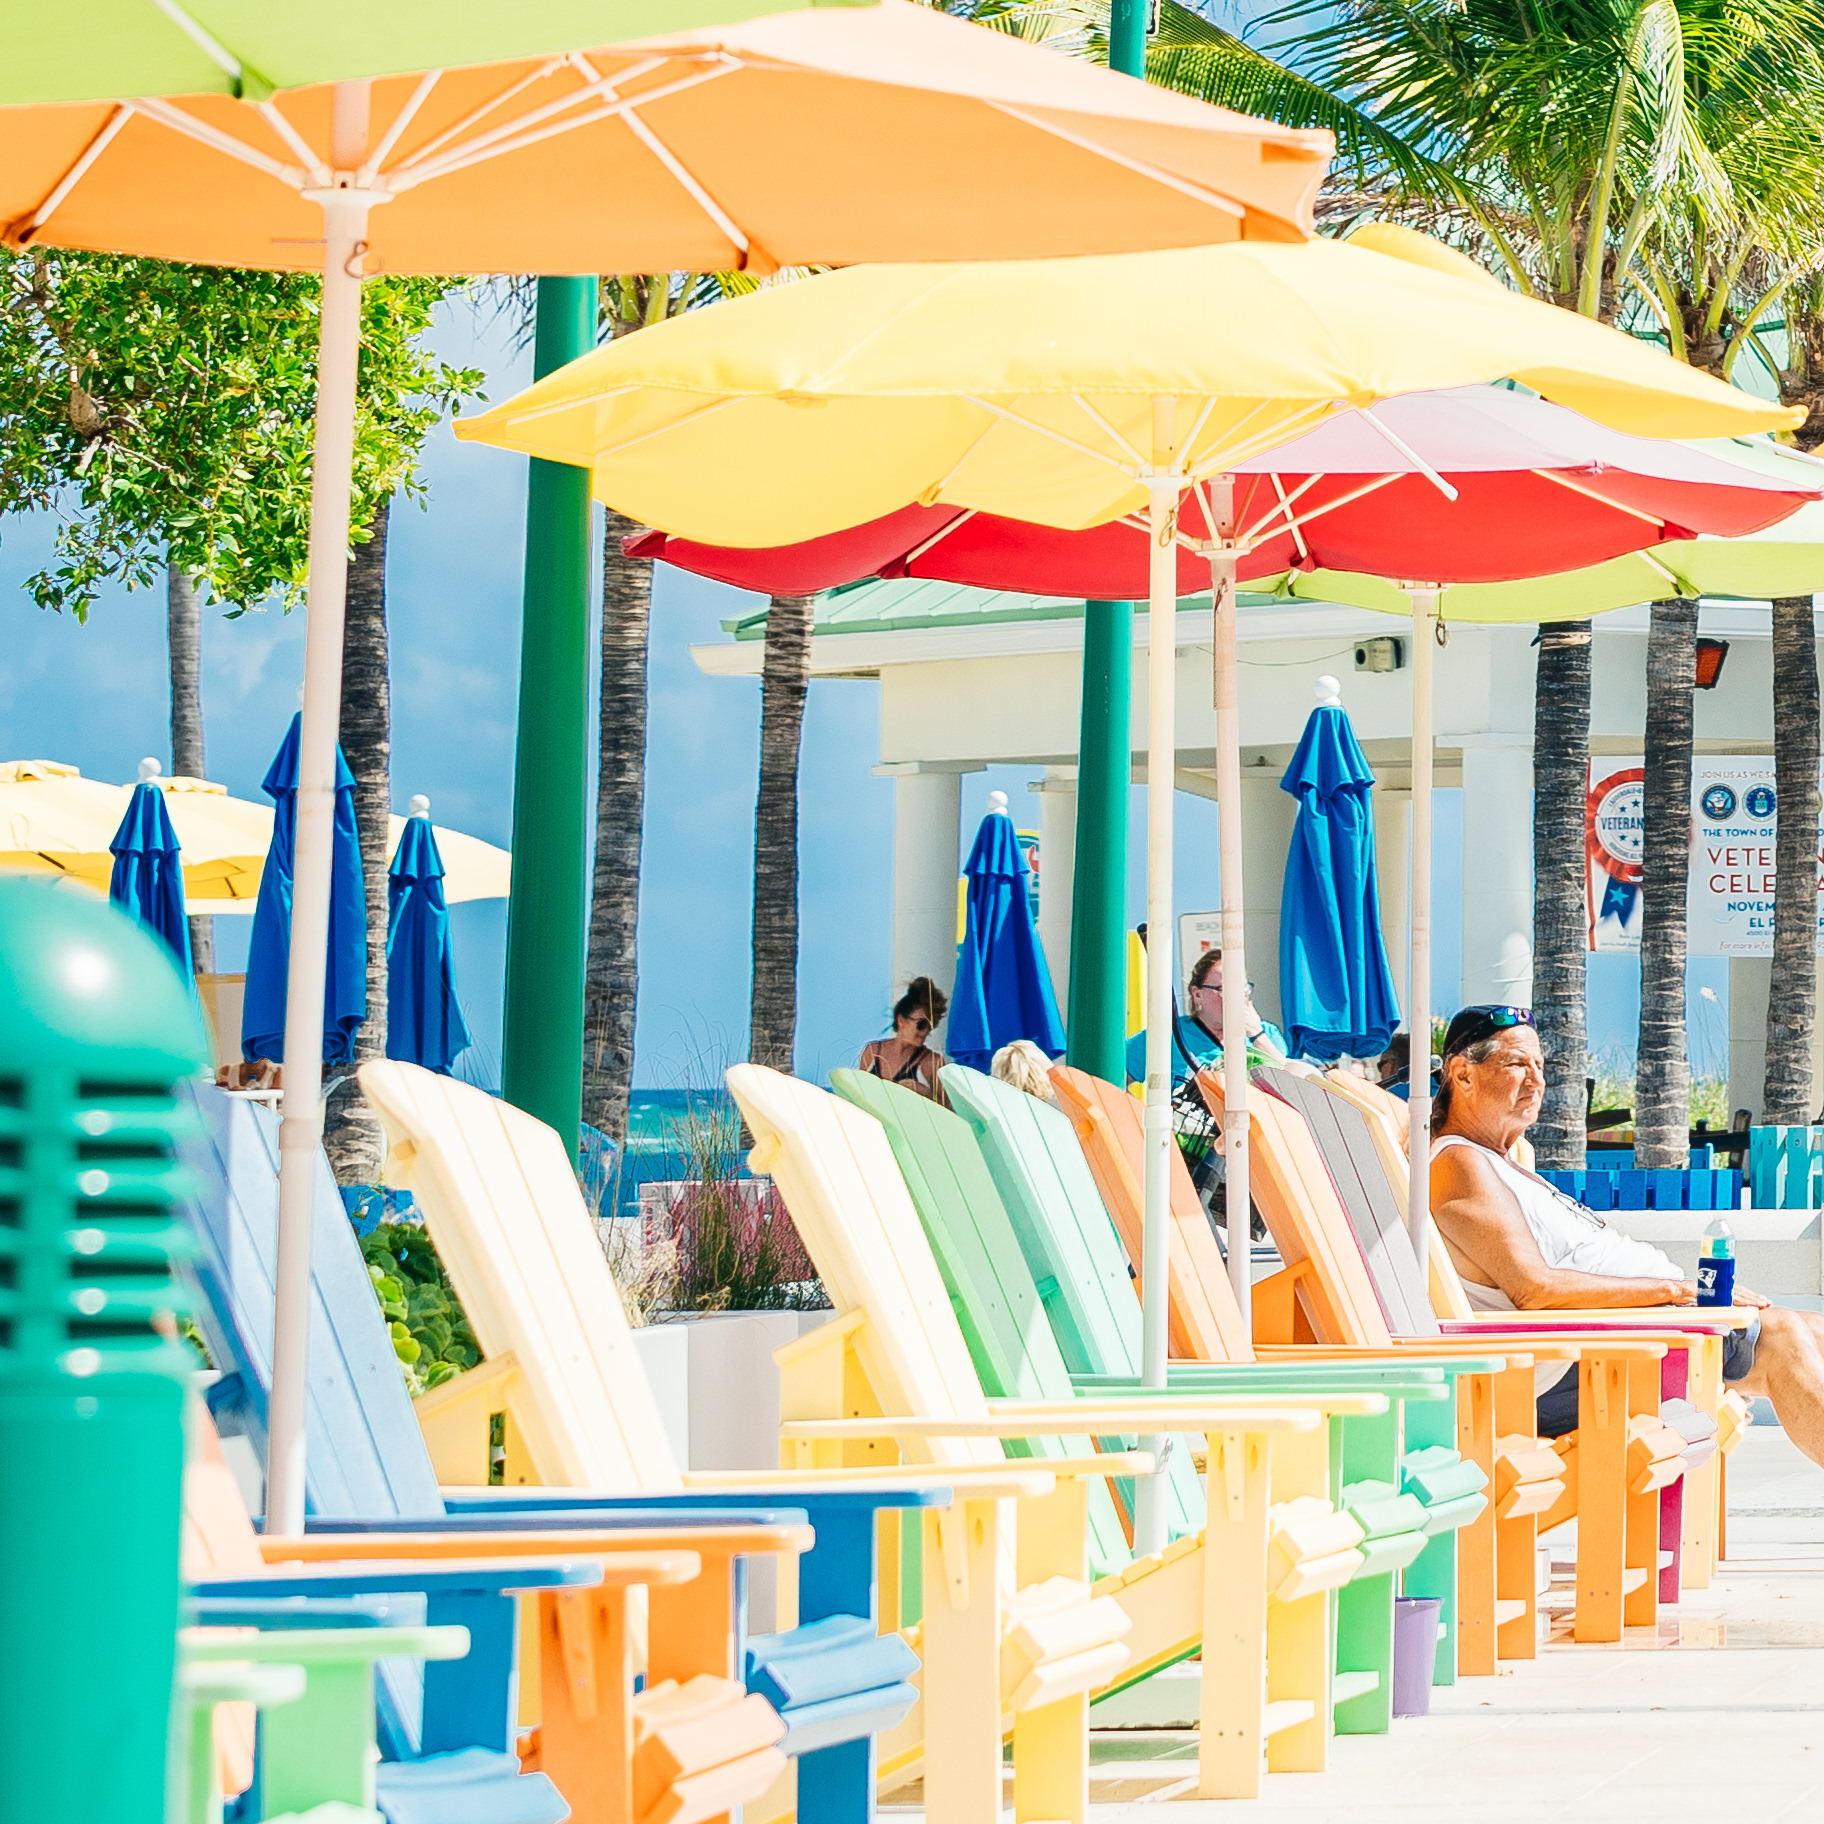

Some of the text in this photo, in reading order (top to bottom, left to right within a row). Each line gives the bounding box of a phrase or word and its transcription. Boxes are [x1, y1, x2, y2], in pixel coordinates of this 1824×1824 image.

[1601, 817, 1644, 830] VETERAN
[1703, 828, 1722, 837] THE
[1725, 828, 1757, 837] TOWN
[1760, 828, 1773, 837] OF
[1727, 901, 1776, 912] NOVEM
[1749, 917, 1764, 928] EL
